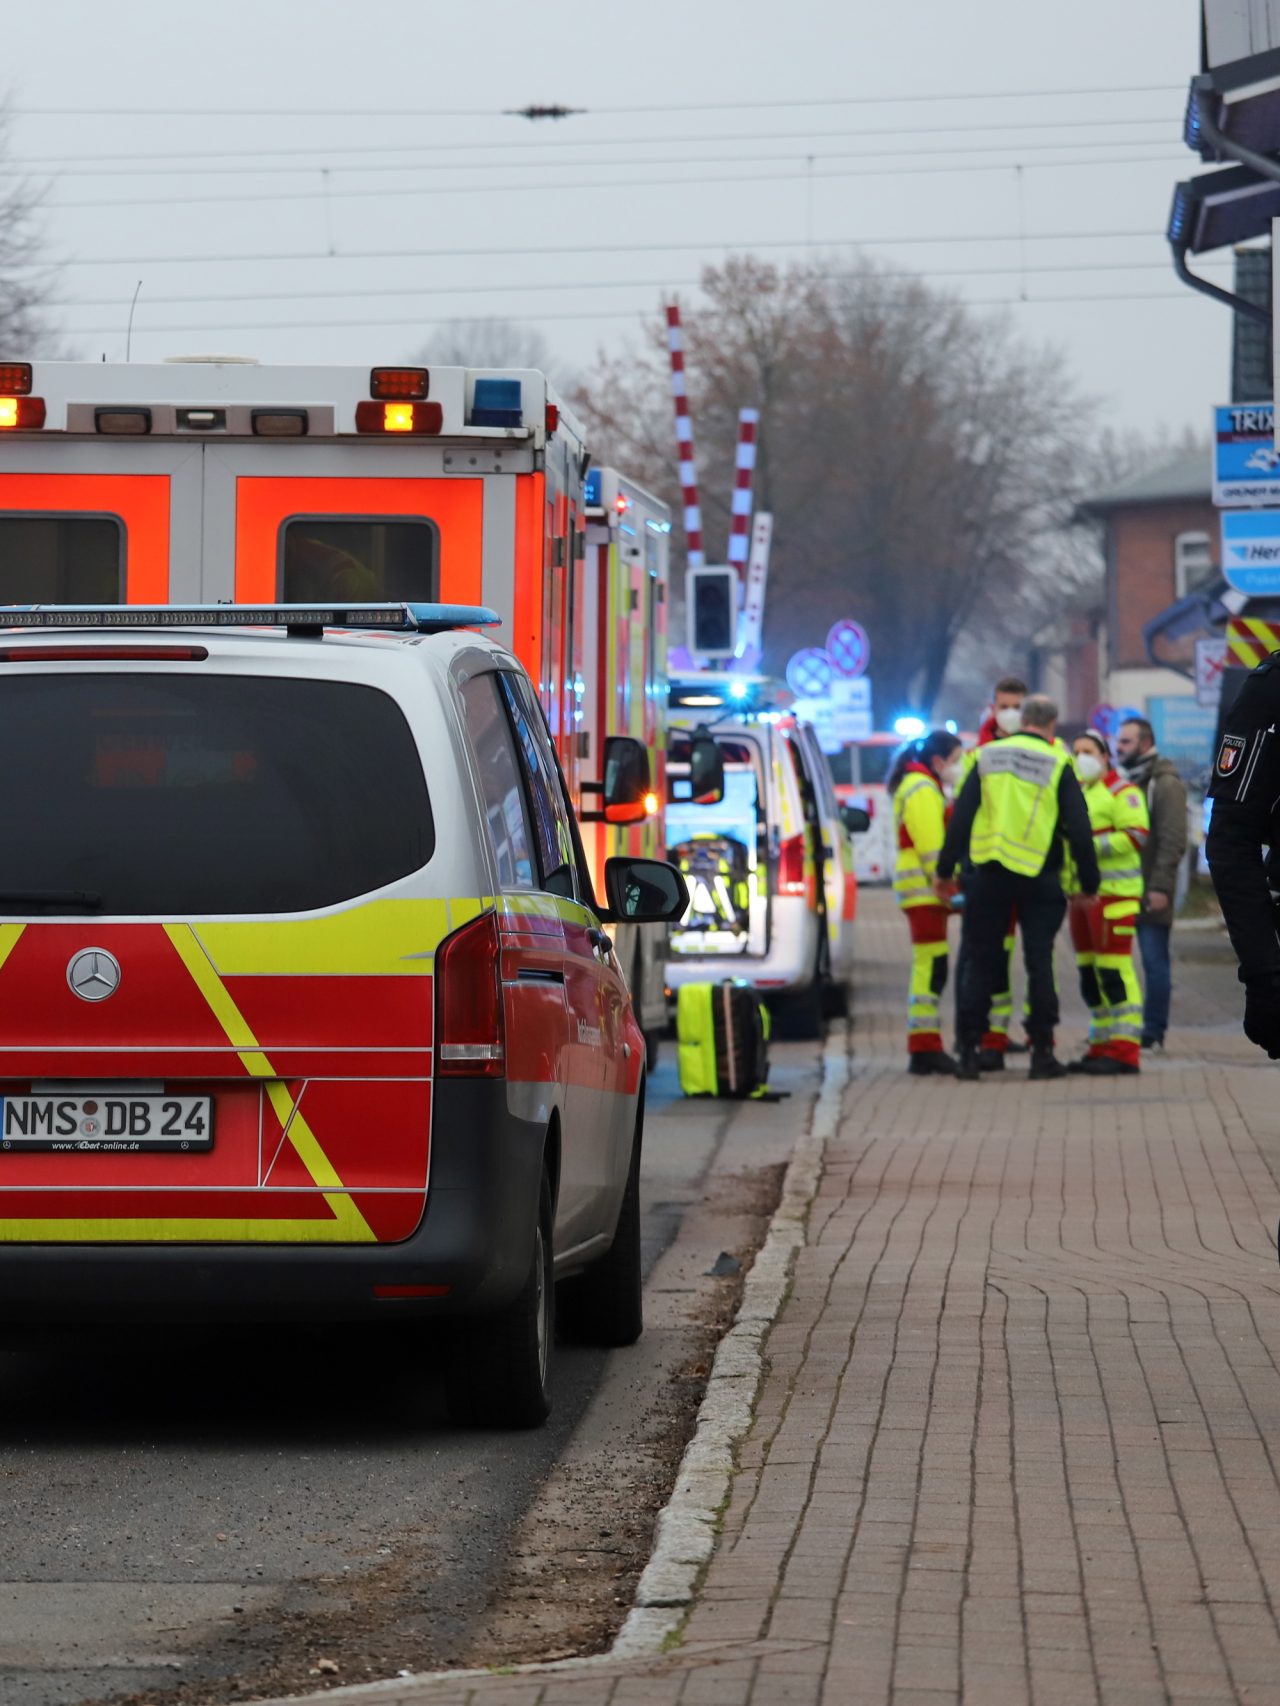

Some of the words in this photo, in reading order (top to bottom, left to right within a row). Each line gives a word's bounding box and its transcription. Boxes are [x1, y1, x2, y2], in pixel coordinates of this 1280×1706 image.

[5, 1101, 78, 1135] NMS
[105, 1101, 151, 1135] DB
[161, 1101, 206, 1135] 24
